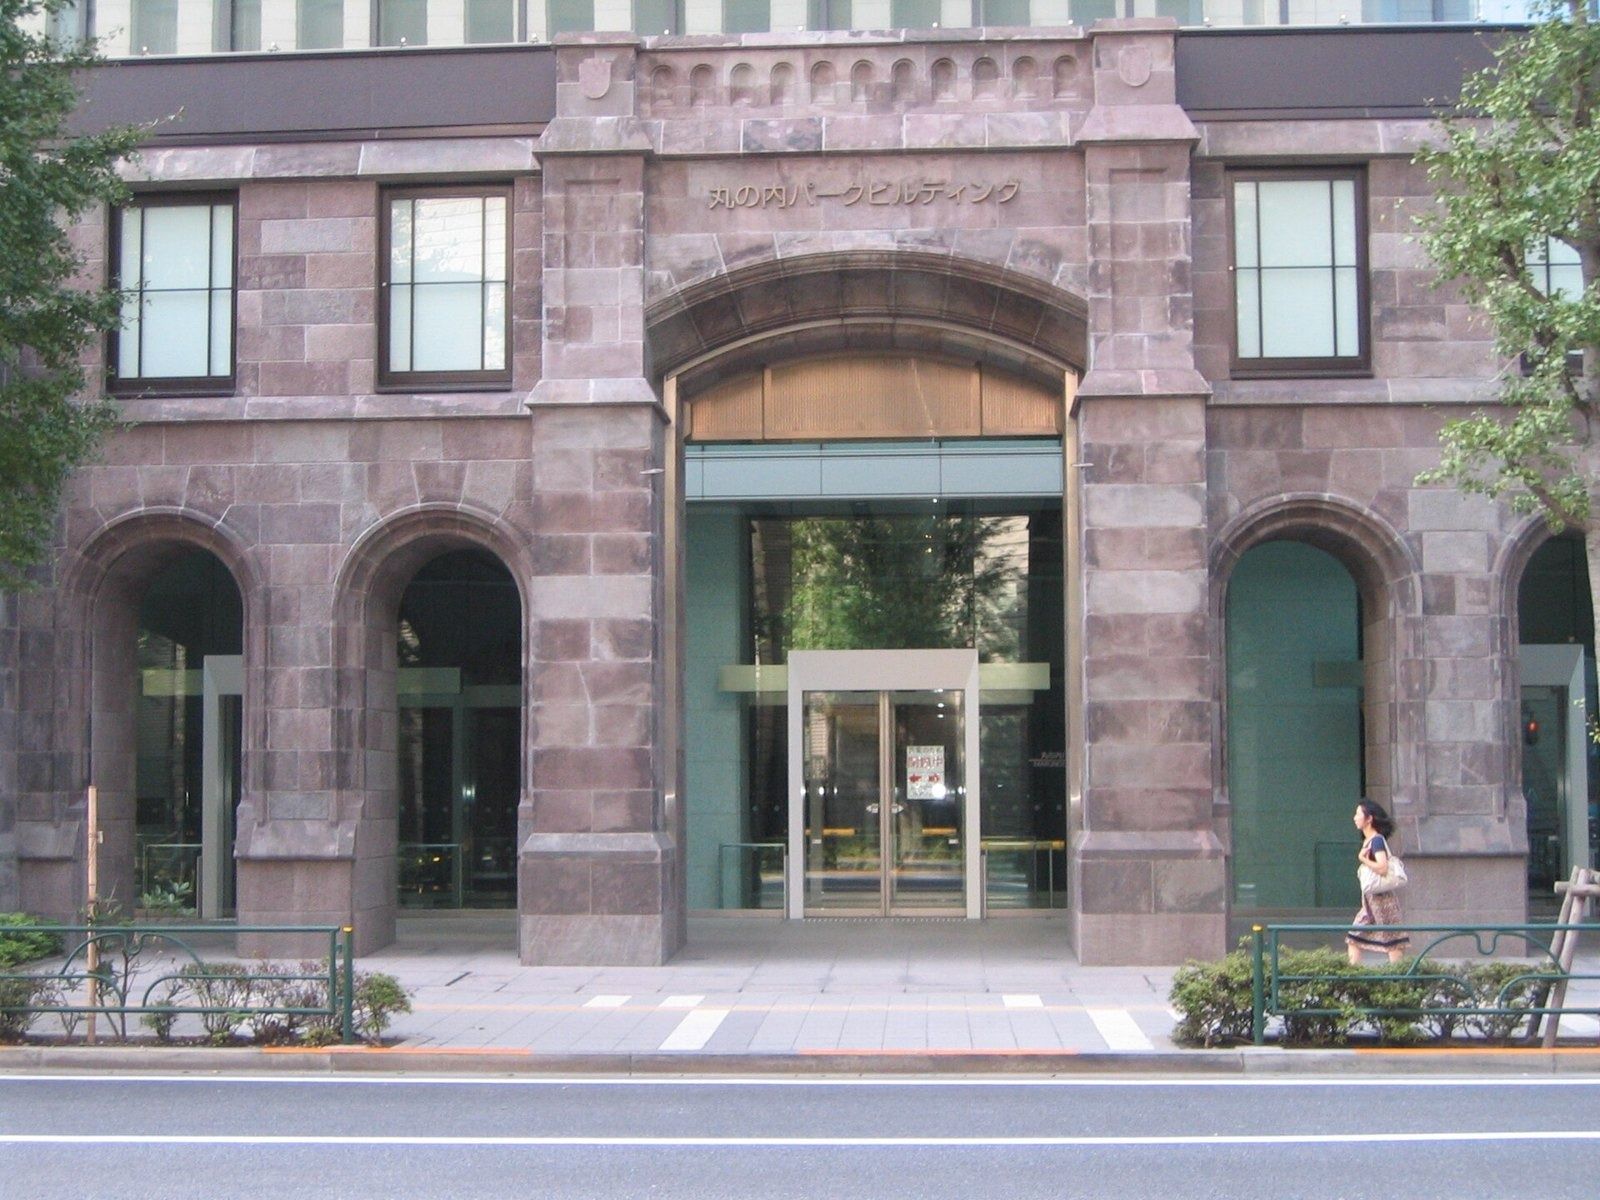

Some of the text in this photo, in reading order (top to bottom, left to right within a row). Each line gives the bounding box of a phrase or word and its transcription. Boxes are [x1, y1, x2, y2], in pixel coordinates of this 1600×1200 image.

[708, 180, 1022, 210] 丸の内パークビルディング
